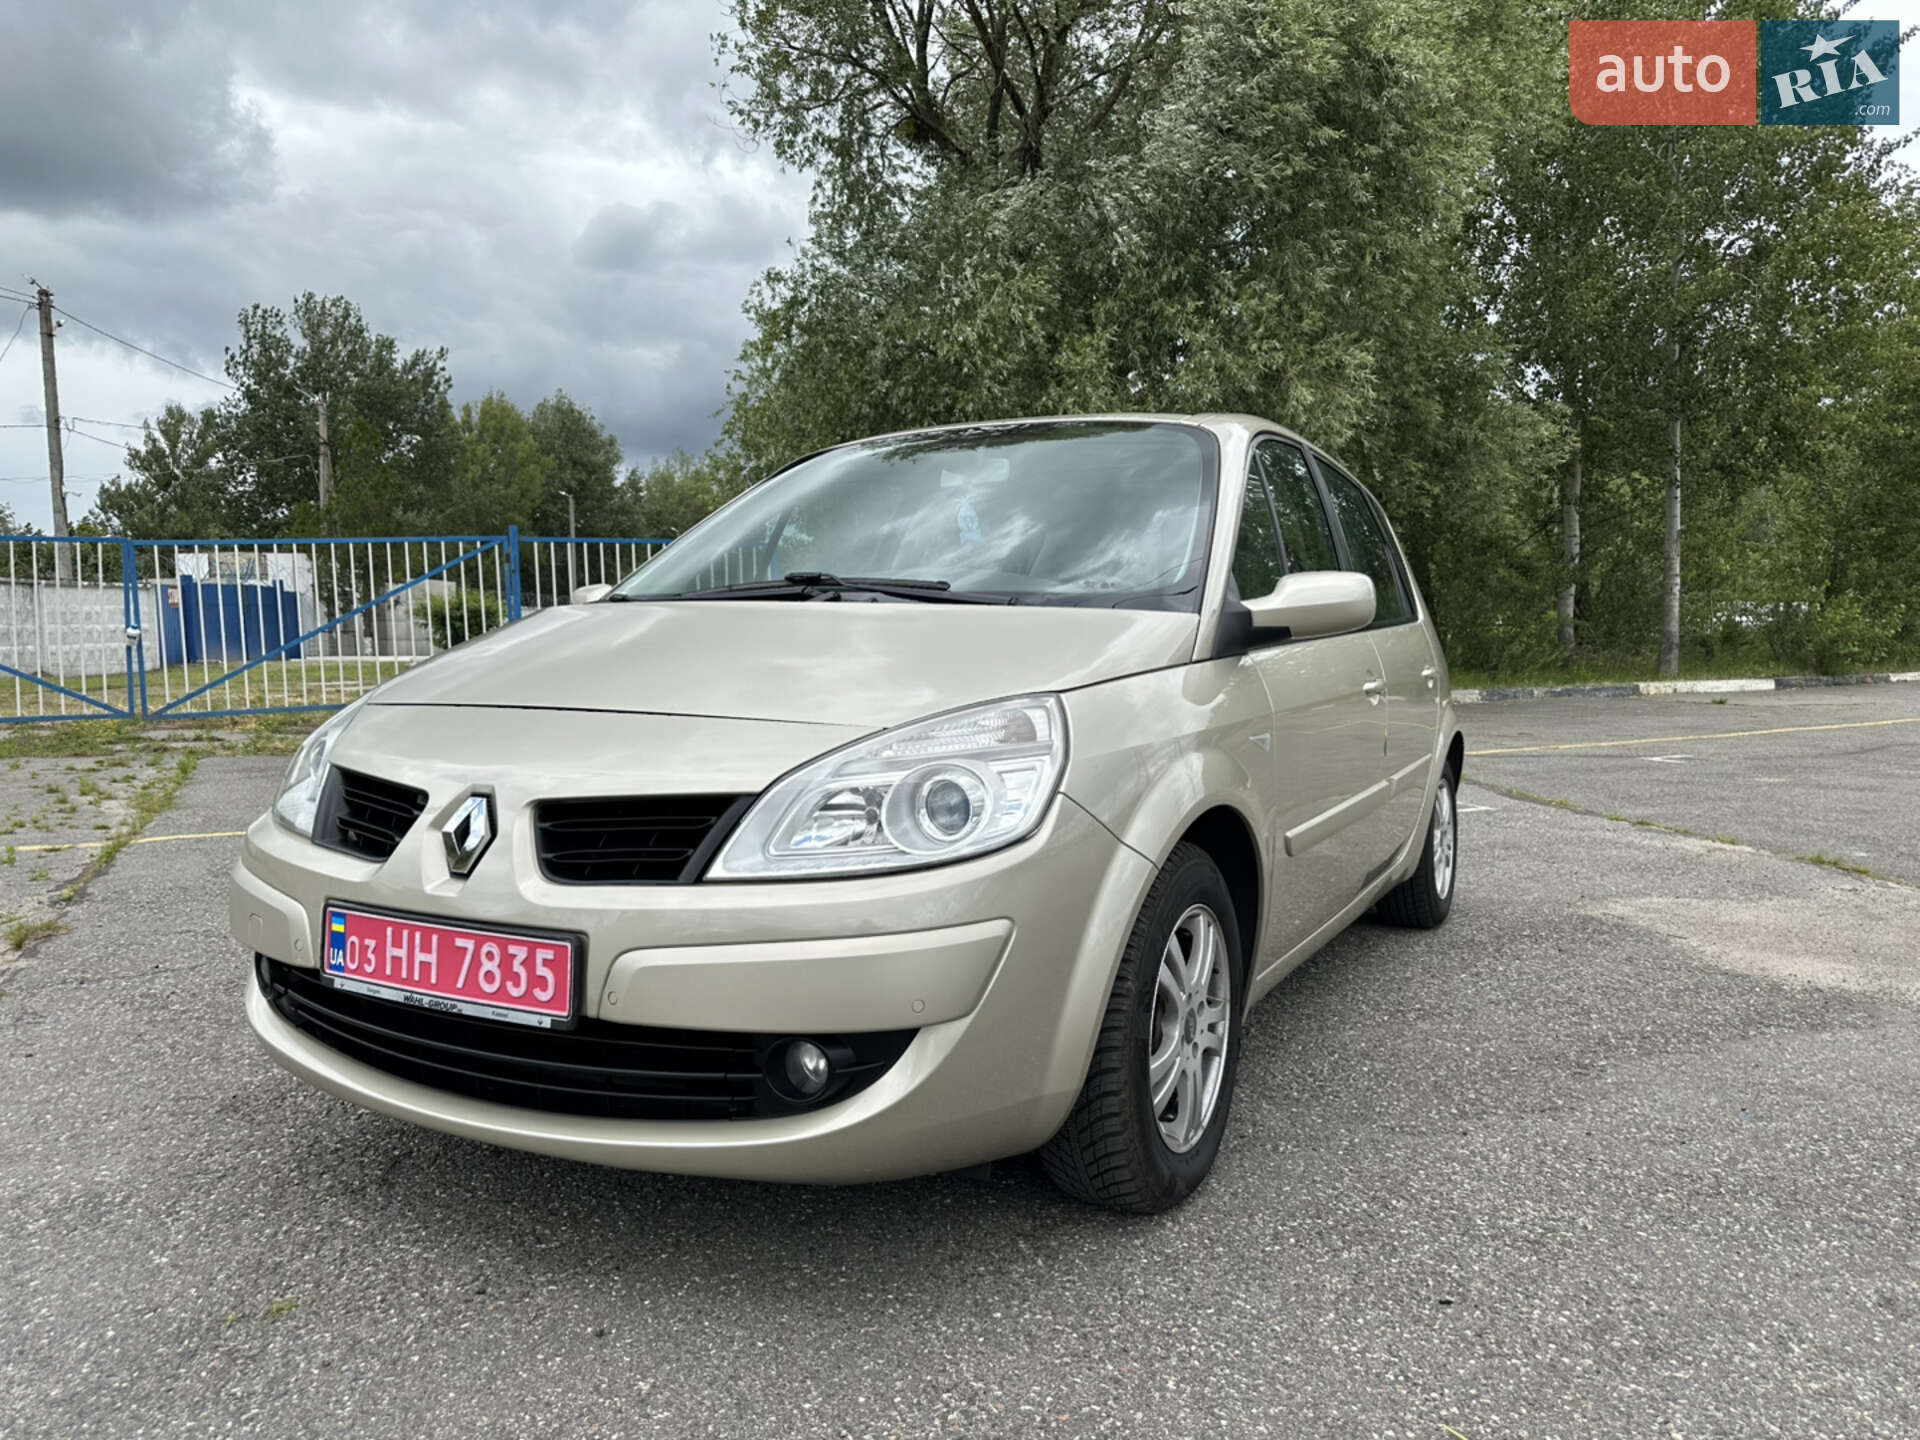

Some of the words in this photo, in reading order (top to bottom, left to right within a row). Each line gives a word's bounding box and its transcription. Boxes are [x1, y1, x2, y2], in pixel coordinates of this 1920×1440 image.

[330, 947, 344, 966] UA
[347, 935, 377, 974] 03
[386, 926, 438, 985] HH
[454, 937, 556, 1003] 7835
